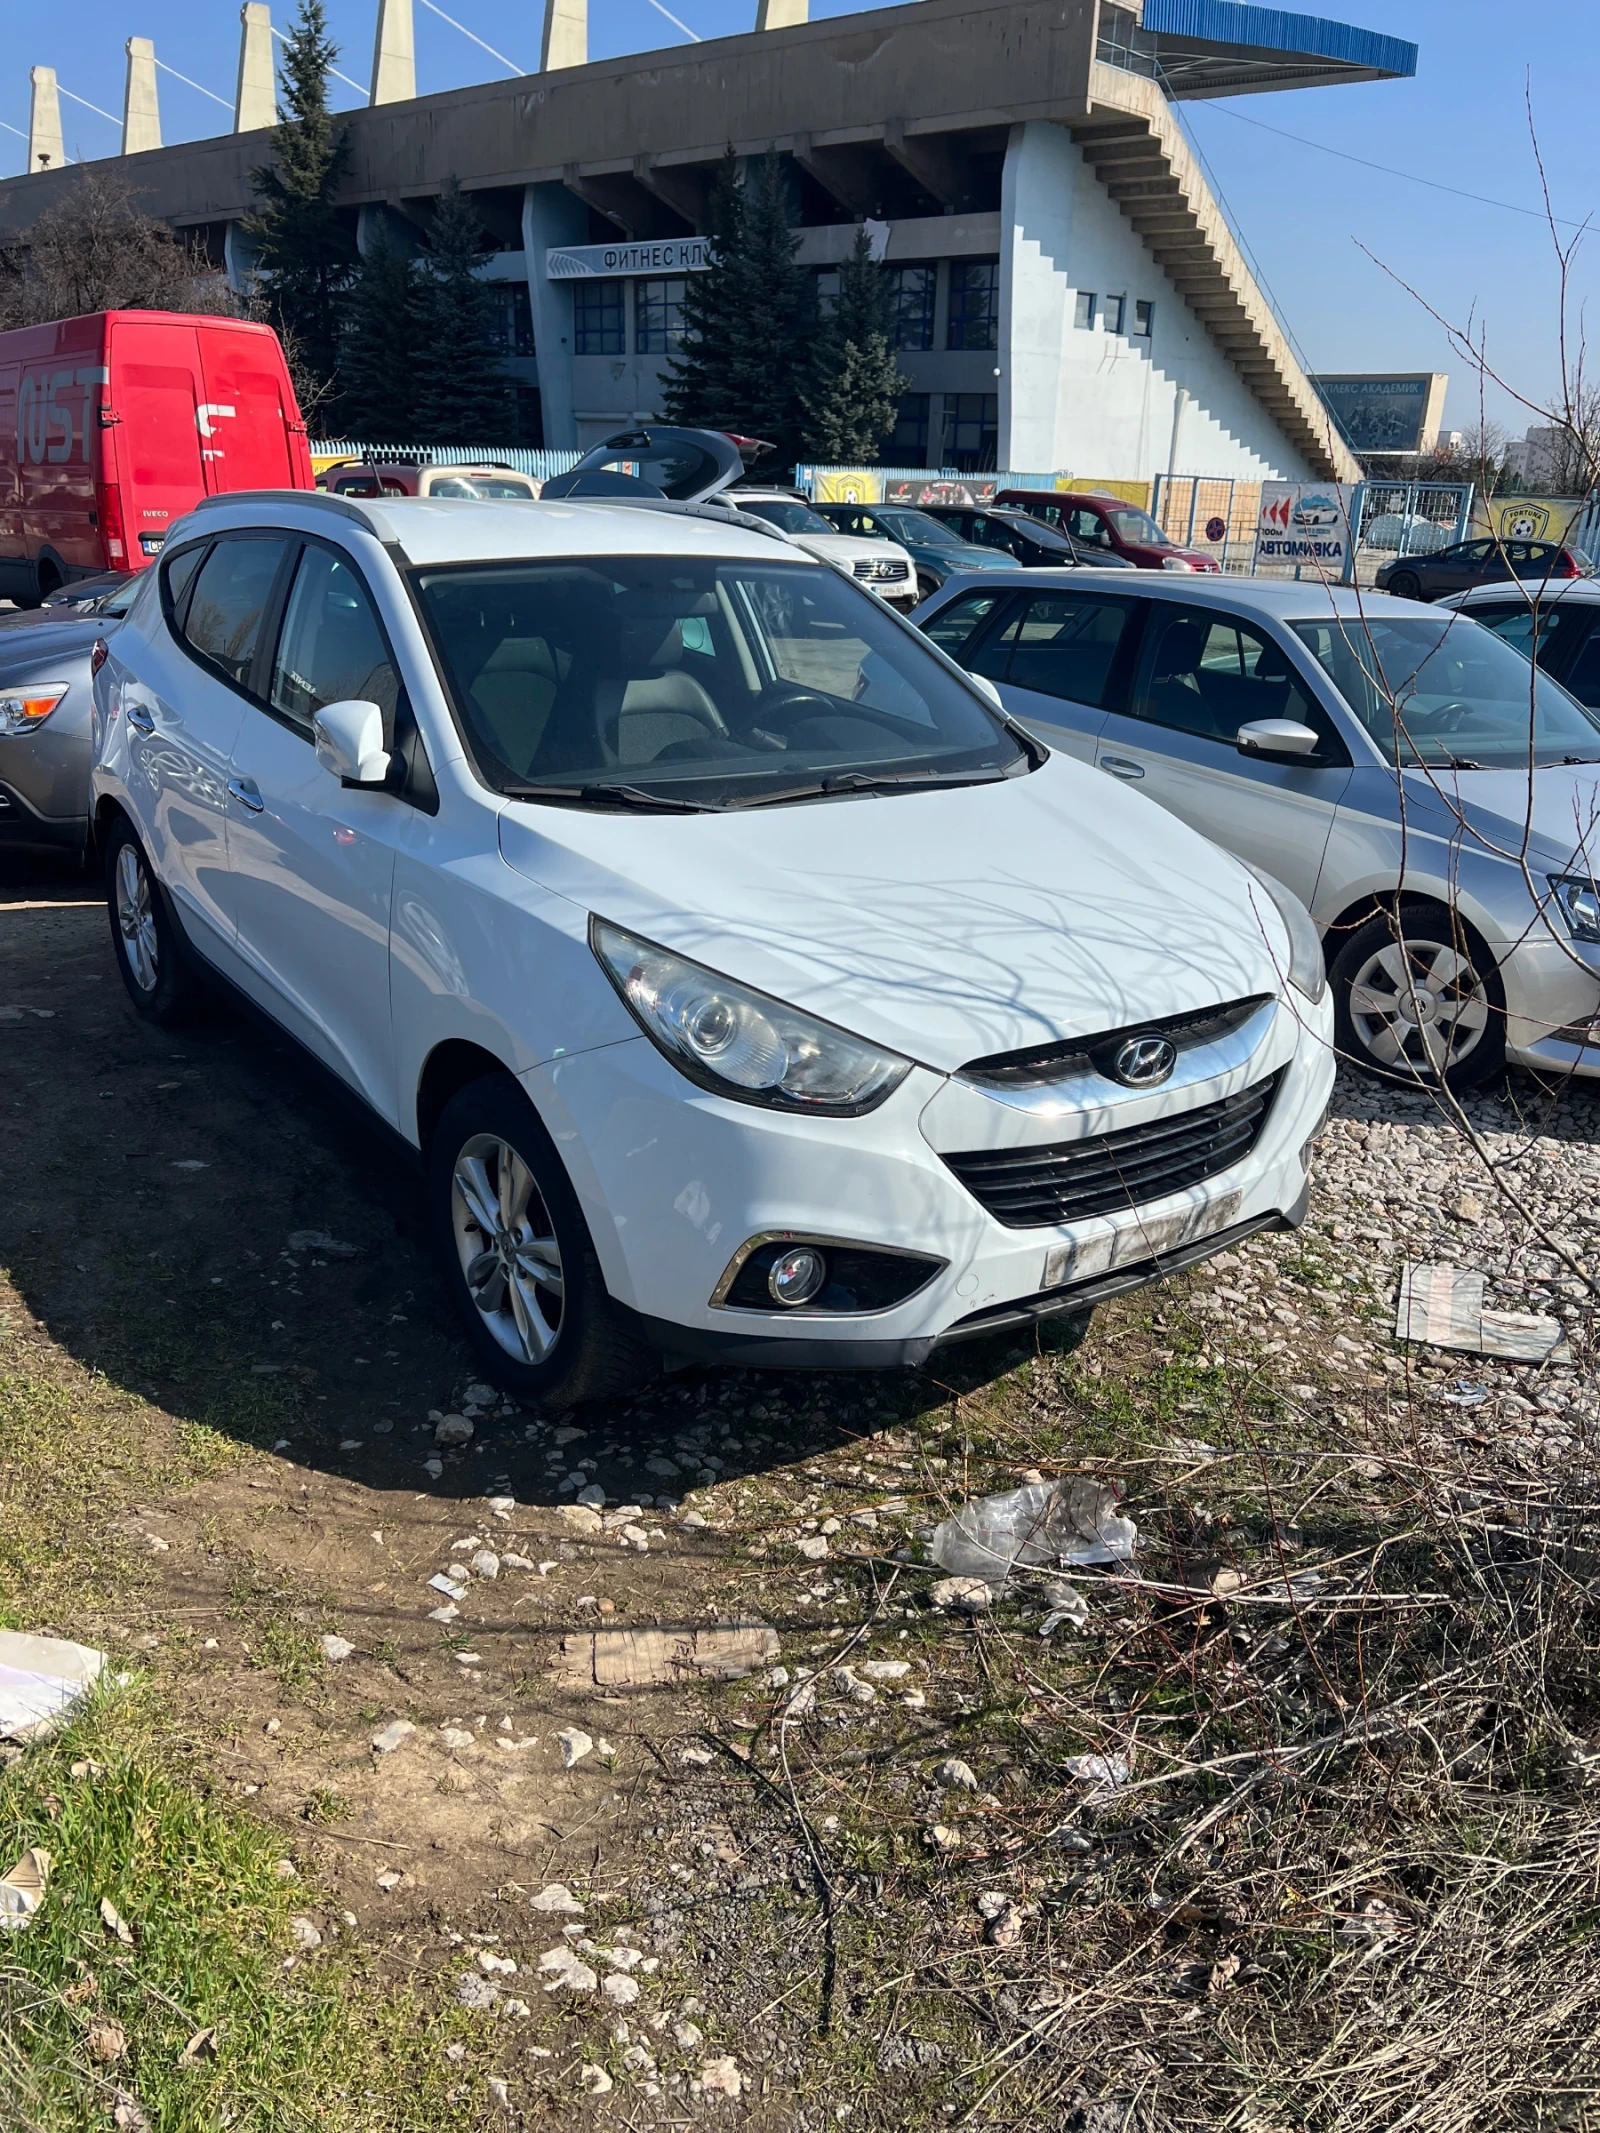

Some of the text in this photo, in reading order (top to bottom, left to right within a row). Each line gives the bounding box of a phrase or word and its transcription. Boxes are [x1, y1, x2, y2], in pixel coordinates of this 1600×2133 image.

[604, 246, 674, 270] ФИТНЕС
[1360, 383, 1420, 395] АКАДЕМИК
[142, 510, 169, 518] IVECO
[1510, 509, 1543, 520] FORTUNA
[1258, 540, 1343, 558] АВТОМИВКА
